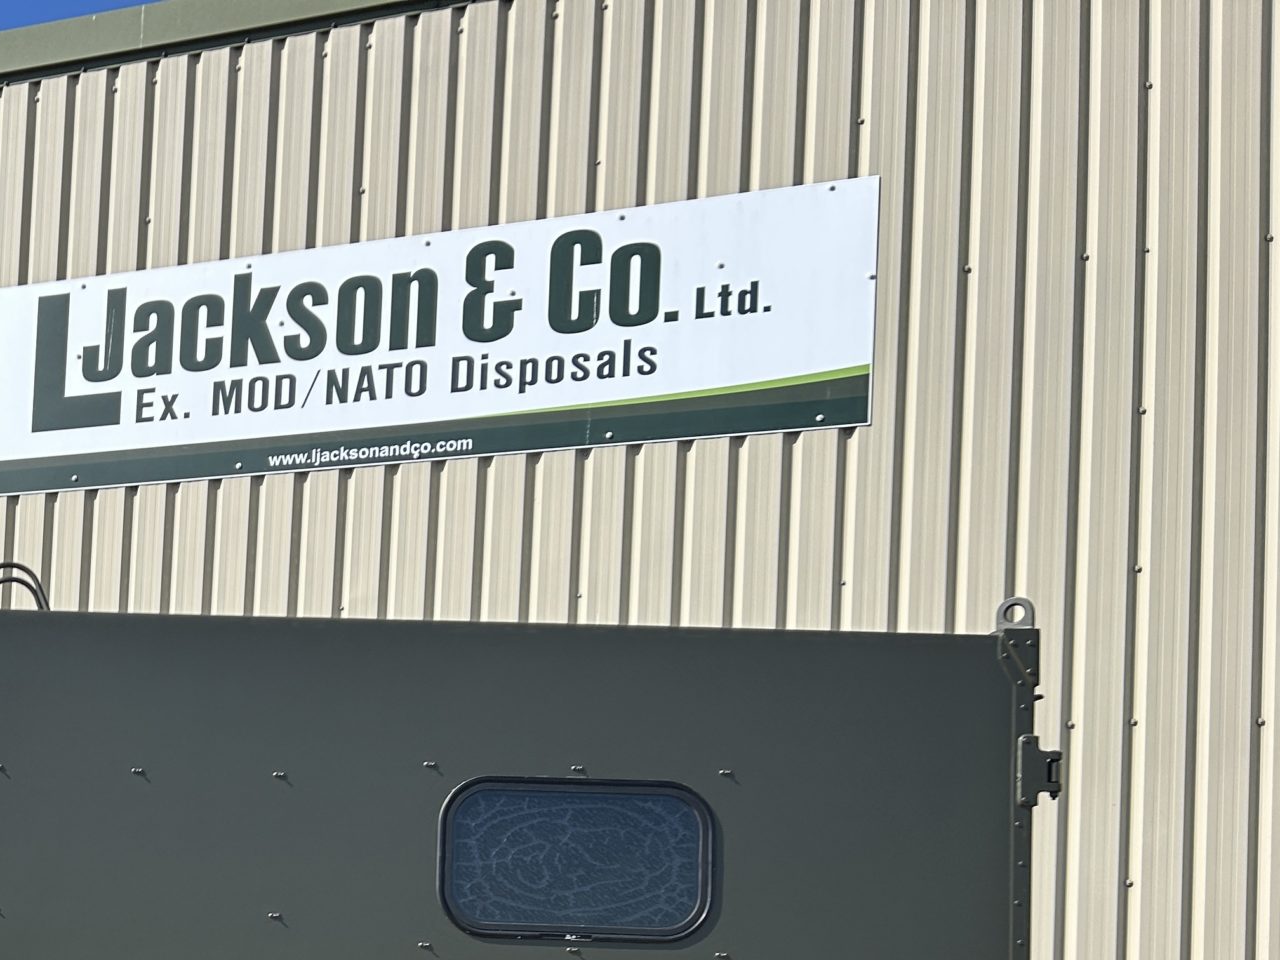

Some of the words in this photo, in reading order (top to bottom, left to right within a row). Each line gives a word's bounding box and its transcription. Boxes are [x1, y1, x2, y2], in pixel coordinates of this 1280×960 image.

[462, 239, 523, 343] &
[547, 228, 680, 335] Co.
[694, 280, 773, 320] Ltd.
[135, 387, 191, 424] Ex.
[211, 359, 428, 416] MOD/NATO
[450, 338, 659, 395] Disposals
[267, 437, 474, 467] www.ljacksonandco.com
